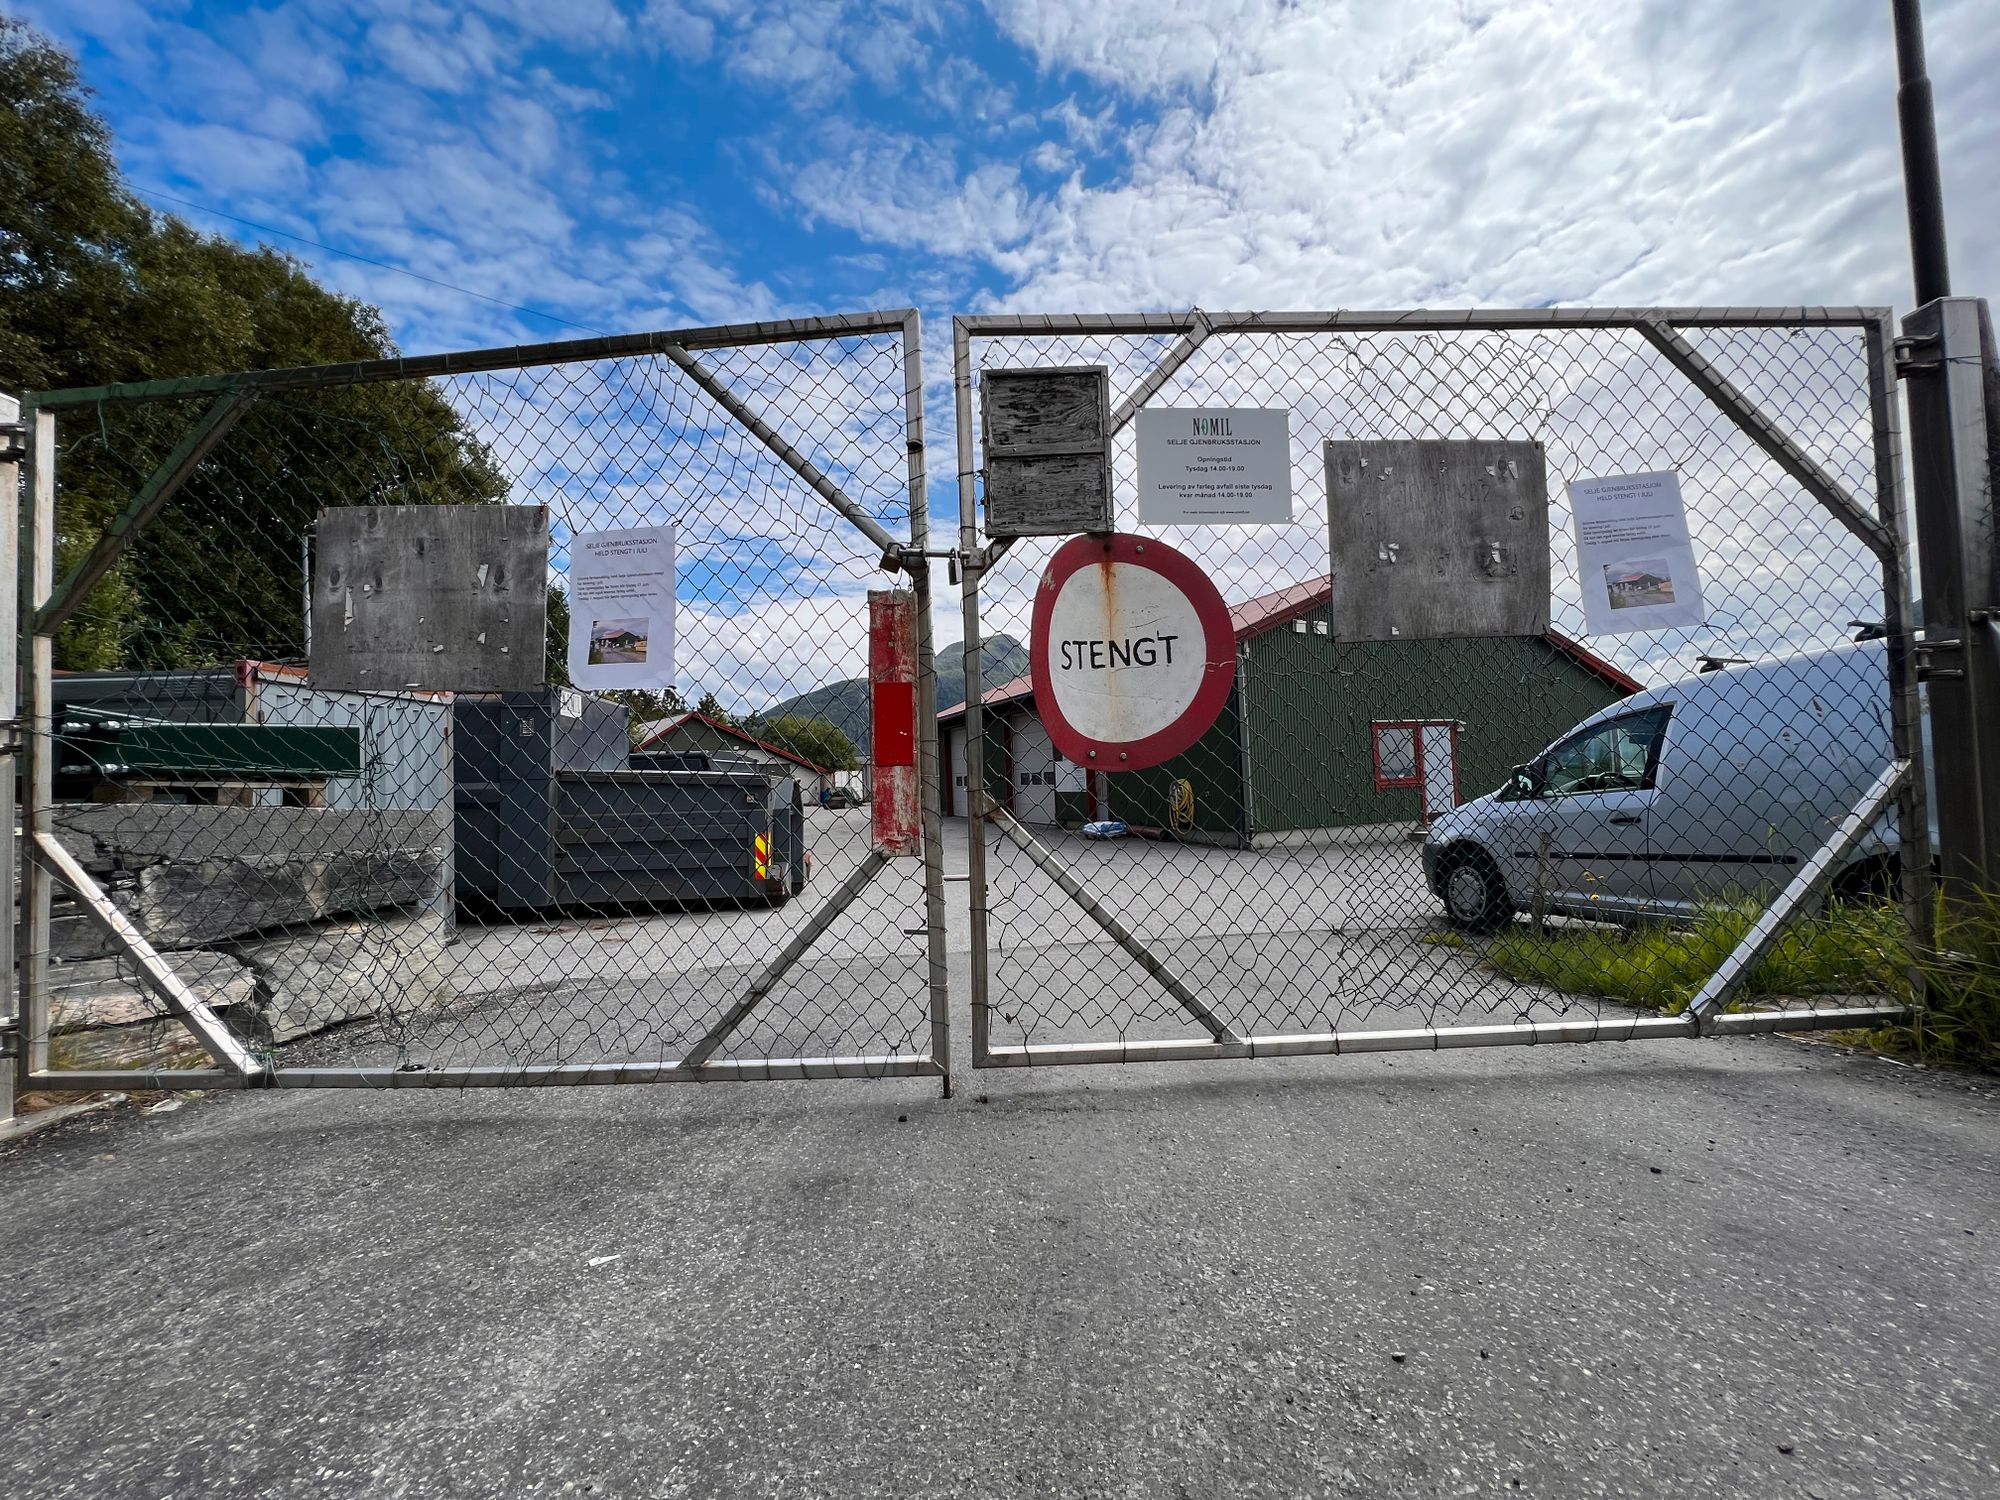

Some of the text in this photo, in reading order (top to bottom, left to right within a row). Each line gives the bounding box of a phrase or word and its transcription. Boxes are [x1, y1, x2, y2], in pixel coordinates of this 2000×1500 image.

[1613, 492, 1636, 500] STENGT
[610, 548, 632, 556] STENGT
[1061, 631, 1178, 670] STENGT
